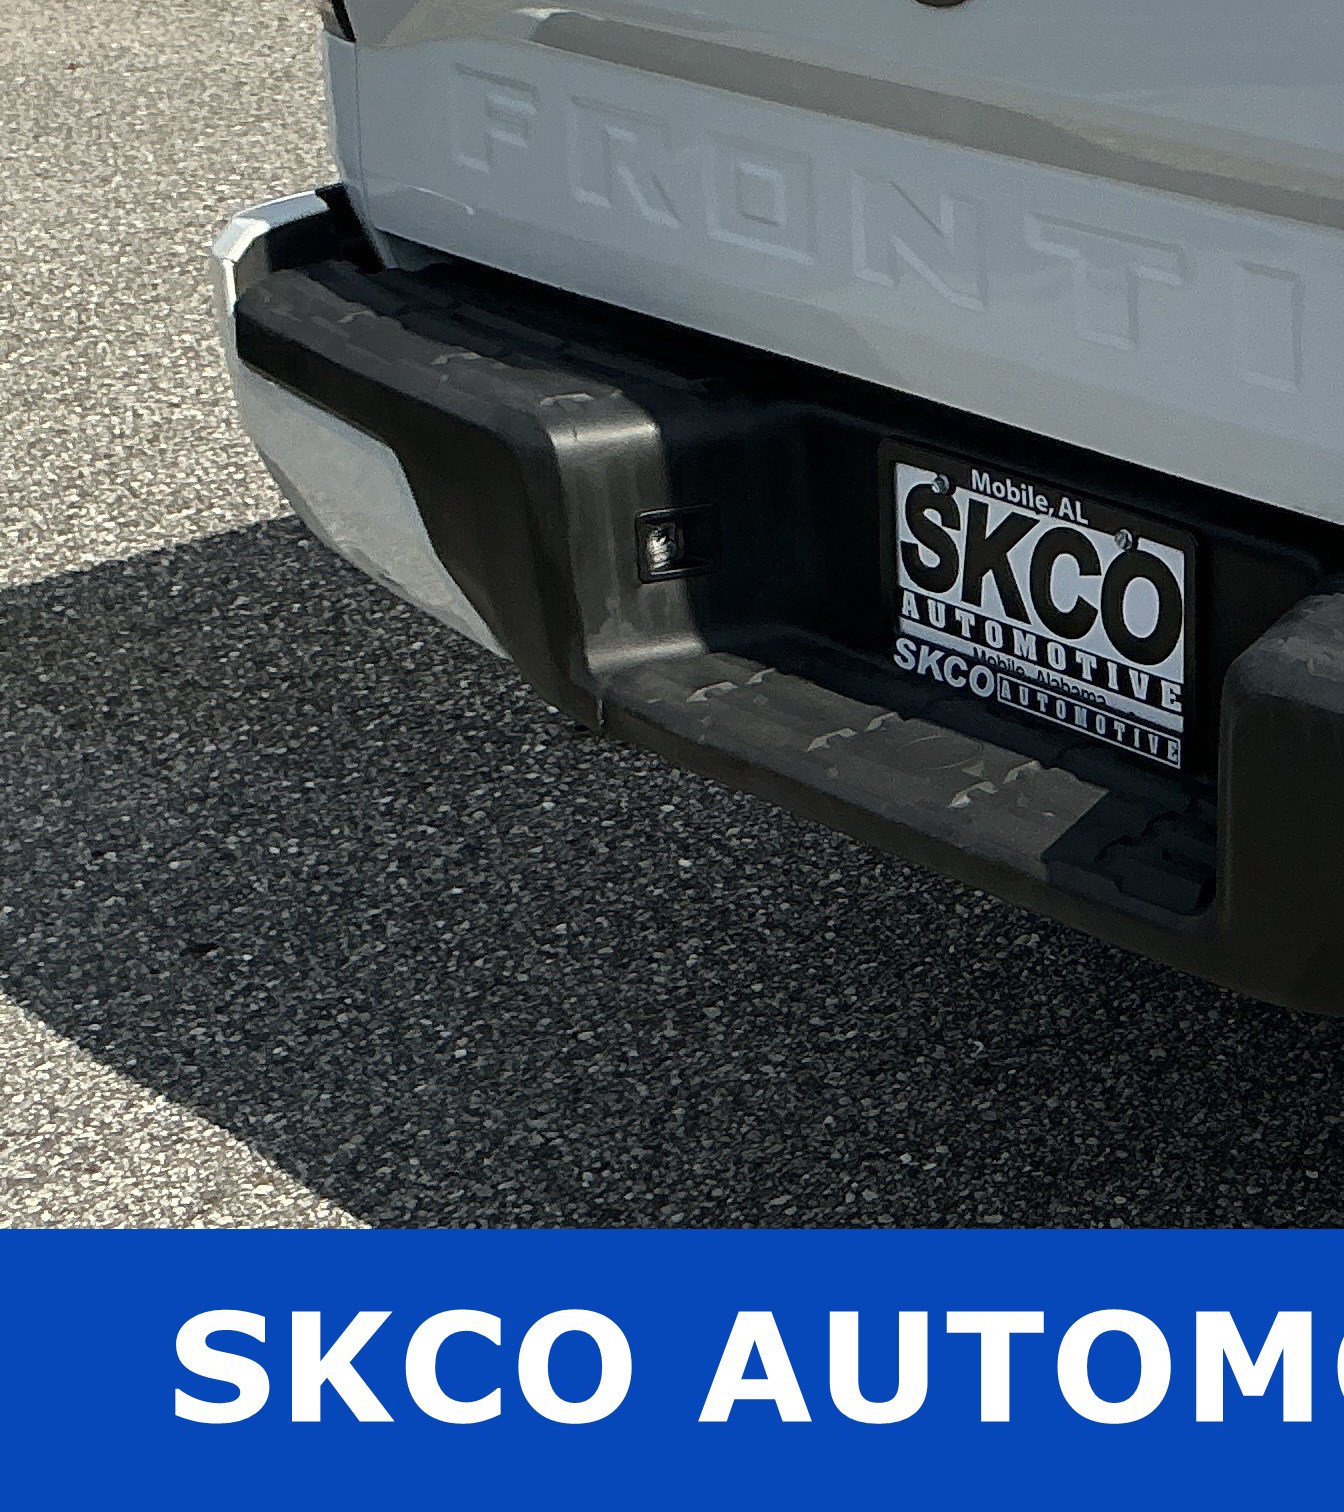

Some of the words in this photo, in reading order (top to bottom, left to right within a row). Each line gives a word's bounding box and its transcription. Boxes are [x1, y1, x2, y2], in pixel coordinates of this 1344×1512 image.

[971, 468, 1055, 518] Mobile,
[1058, 496, 1089, 525] AL
[900, 482, 1183, 666] SKCO
[893, 637, 995, 698] SKCO
[1000, 679, 1179, 762] AUTOMOTIVE
[901, 589, 1182, 713] AUTOMOTIVE
